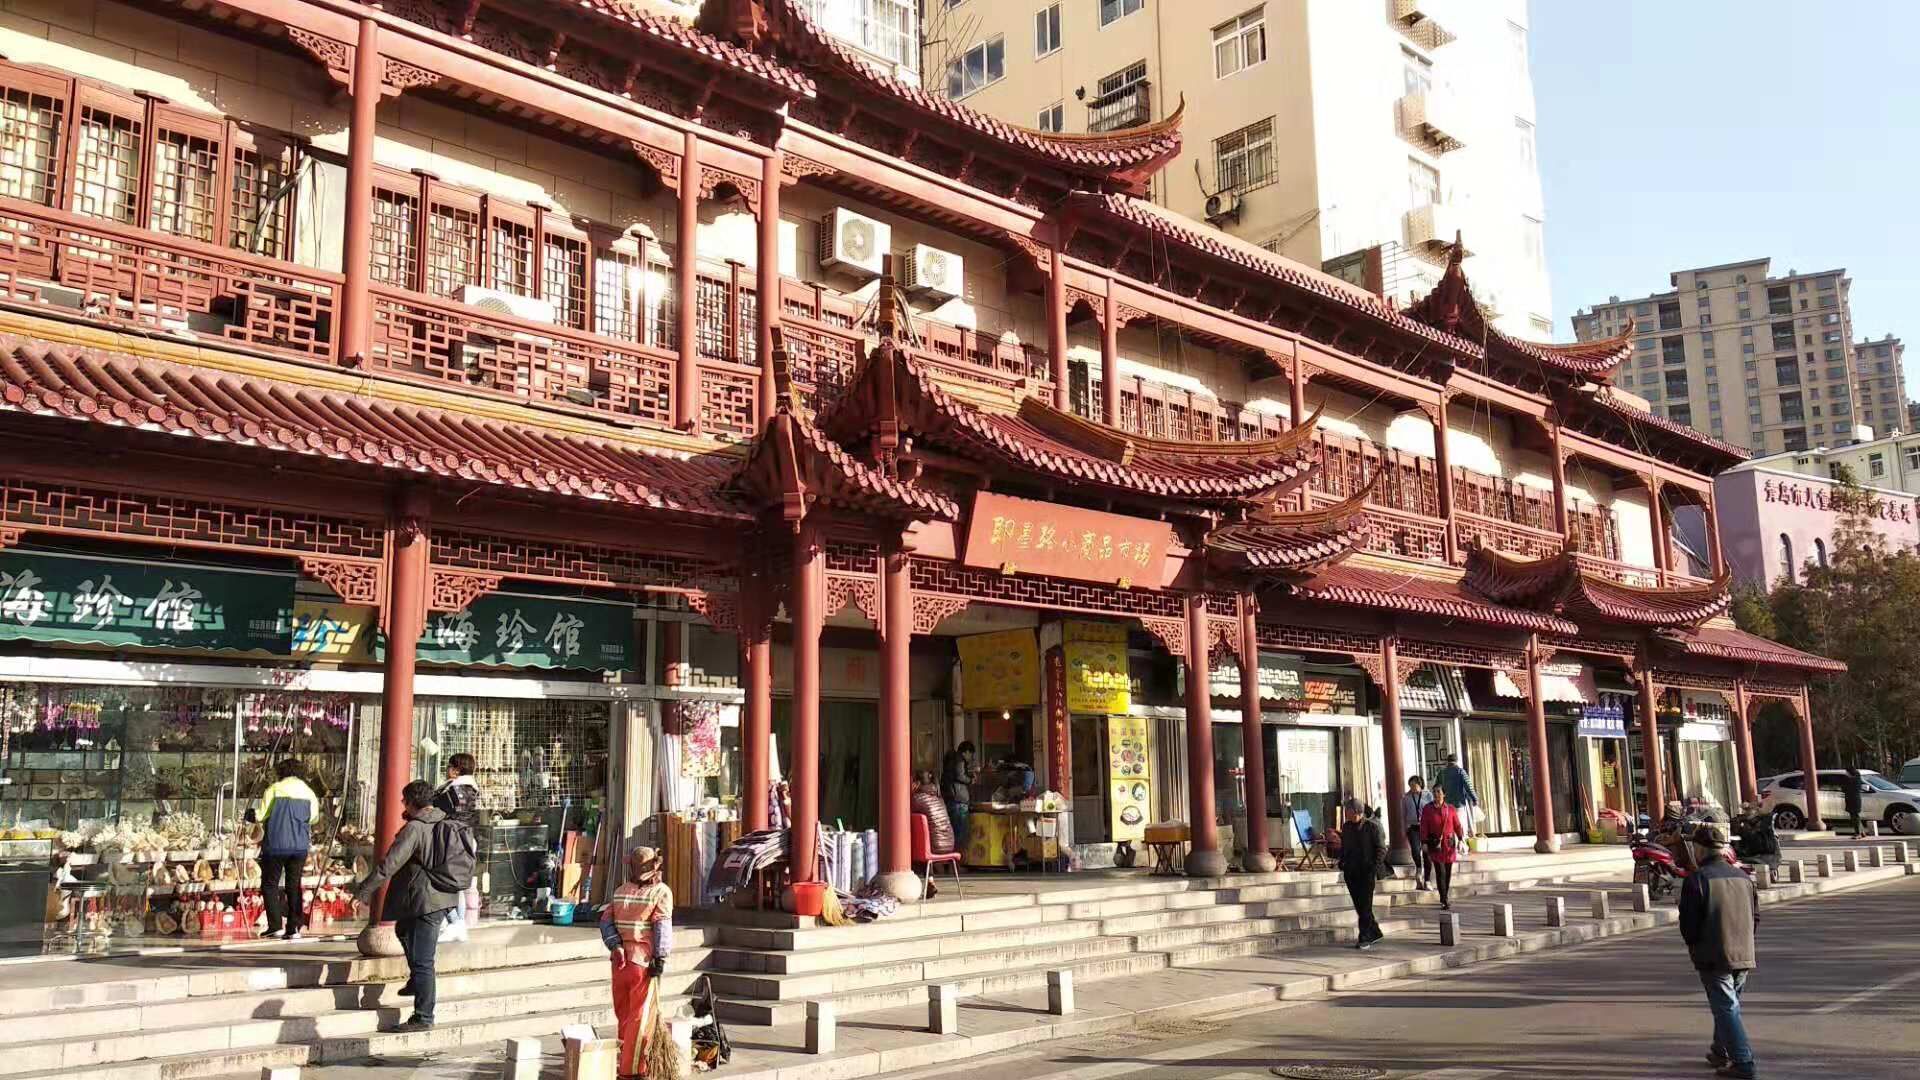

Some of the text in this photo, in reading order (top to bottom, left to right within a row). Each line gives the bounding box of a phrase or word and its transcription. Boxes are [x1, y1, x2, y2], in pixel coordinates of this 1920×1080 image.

[0, 569, 202, 634] 海珍馆
[437, 608, 584, 658] 海珍馆
